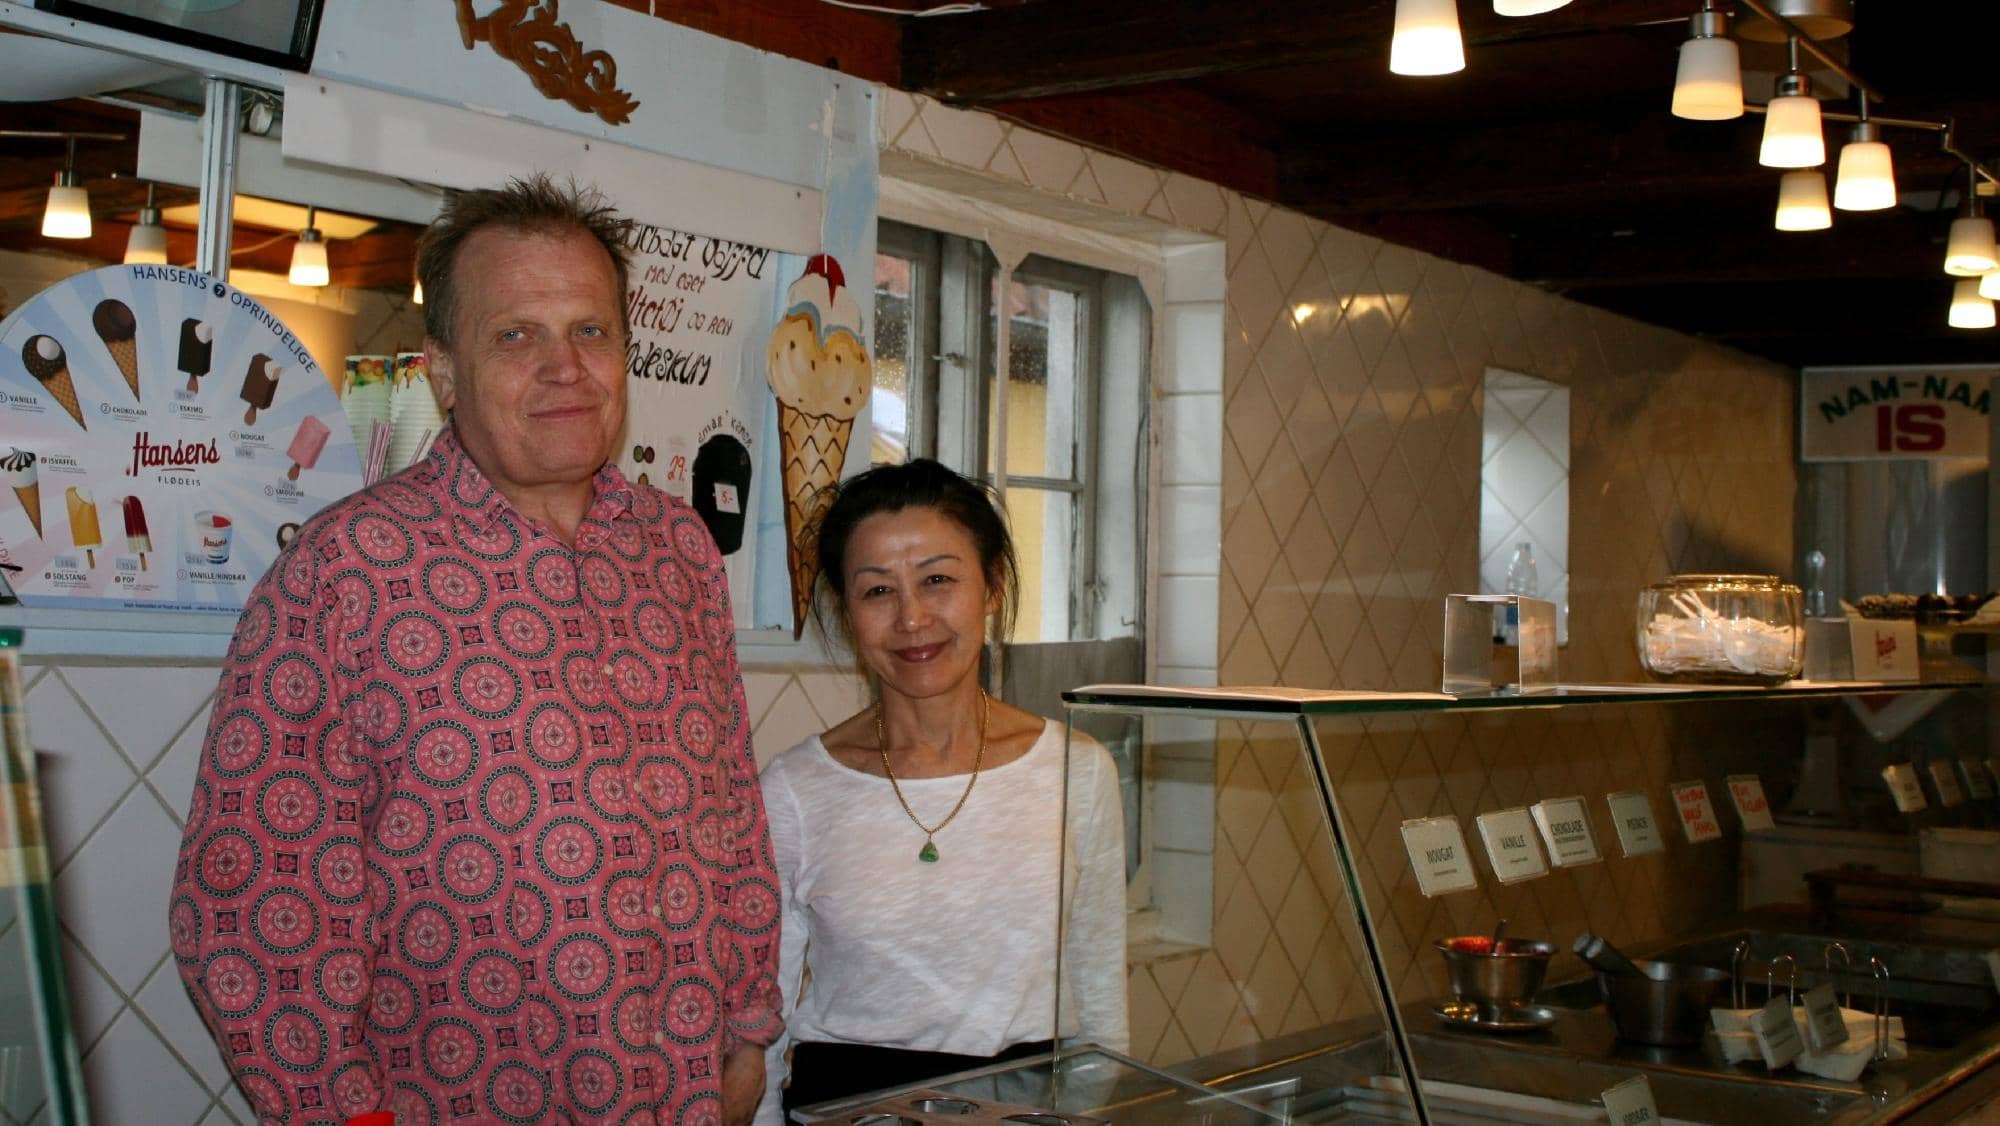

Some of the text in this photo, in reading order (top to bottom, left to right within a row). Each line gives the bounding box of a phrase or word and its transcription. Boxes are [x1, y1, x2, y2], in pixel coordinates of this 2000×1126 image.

[133, 266, 207, 290] HANSENS
[231, 292, 317, 373] OPRINDELIGE
[9, 395, 37, 404] VANILLE
[1876, 403, 1947, 452] IS
[126, 431, 220, 477] Hansens
[158, 476, 201, 486] FLØDEIS
[52, 573, 87, 581] SOLSTANG
[1501, 834, 1527, 850] VANILLE
[1425, 846, 1455, 865] NOUGAT
